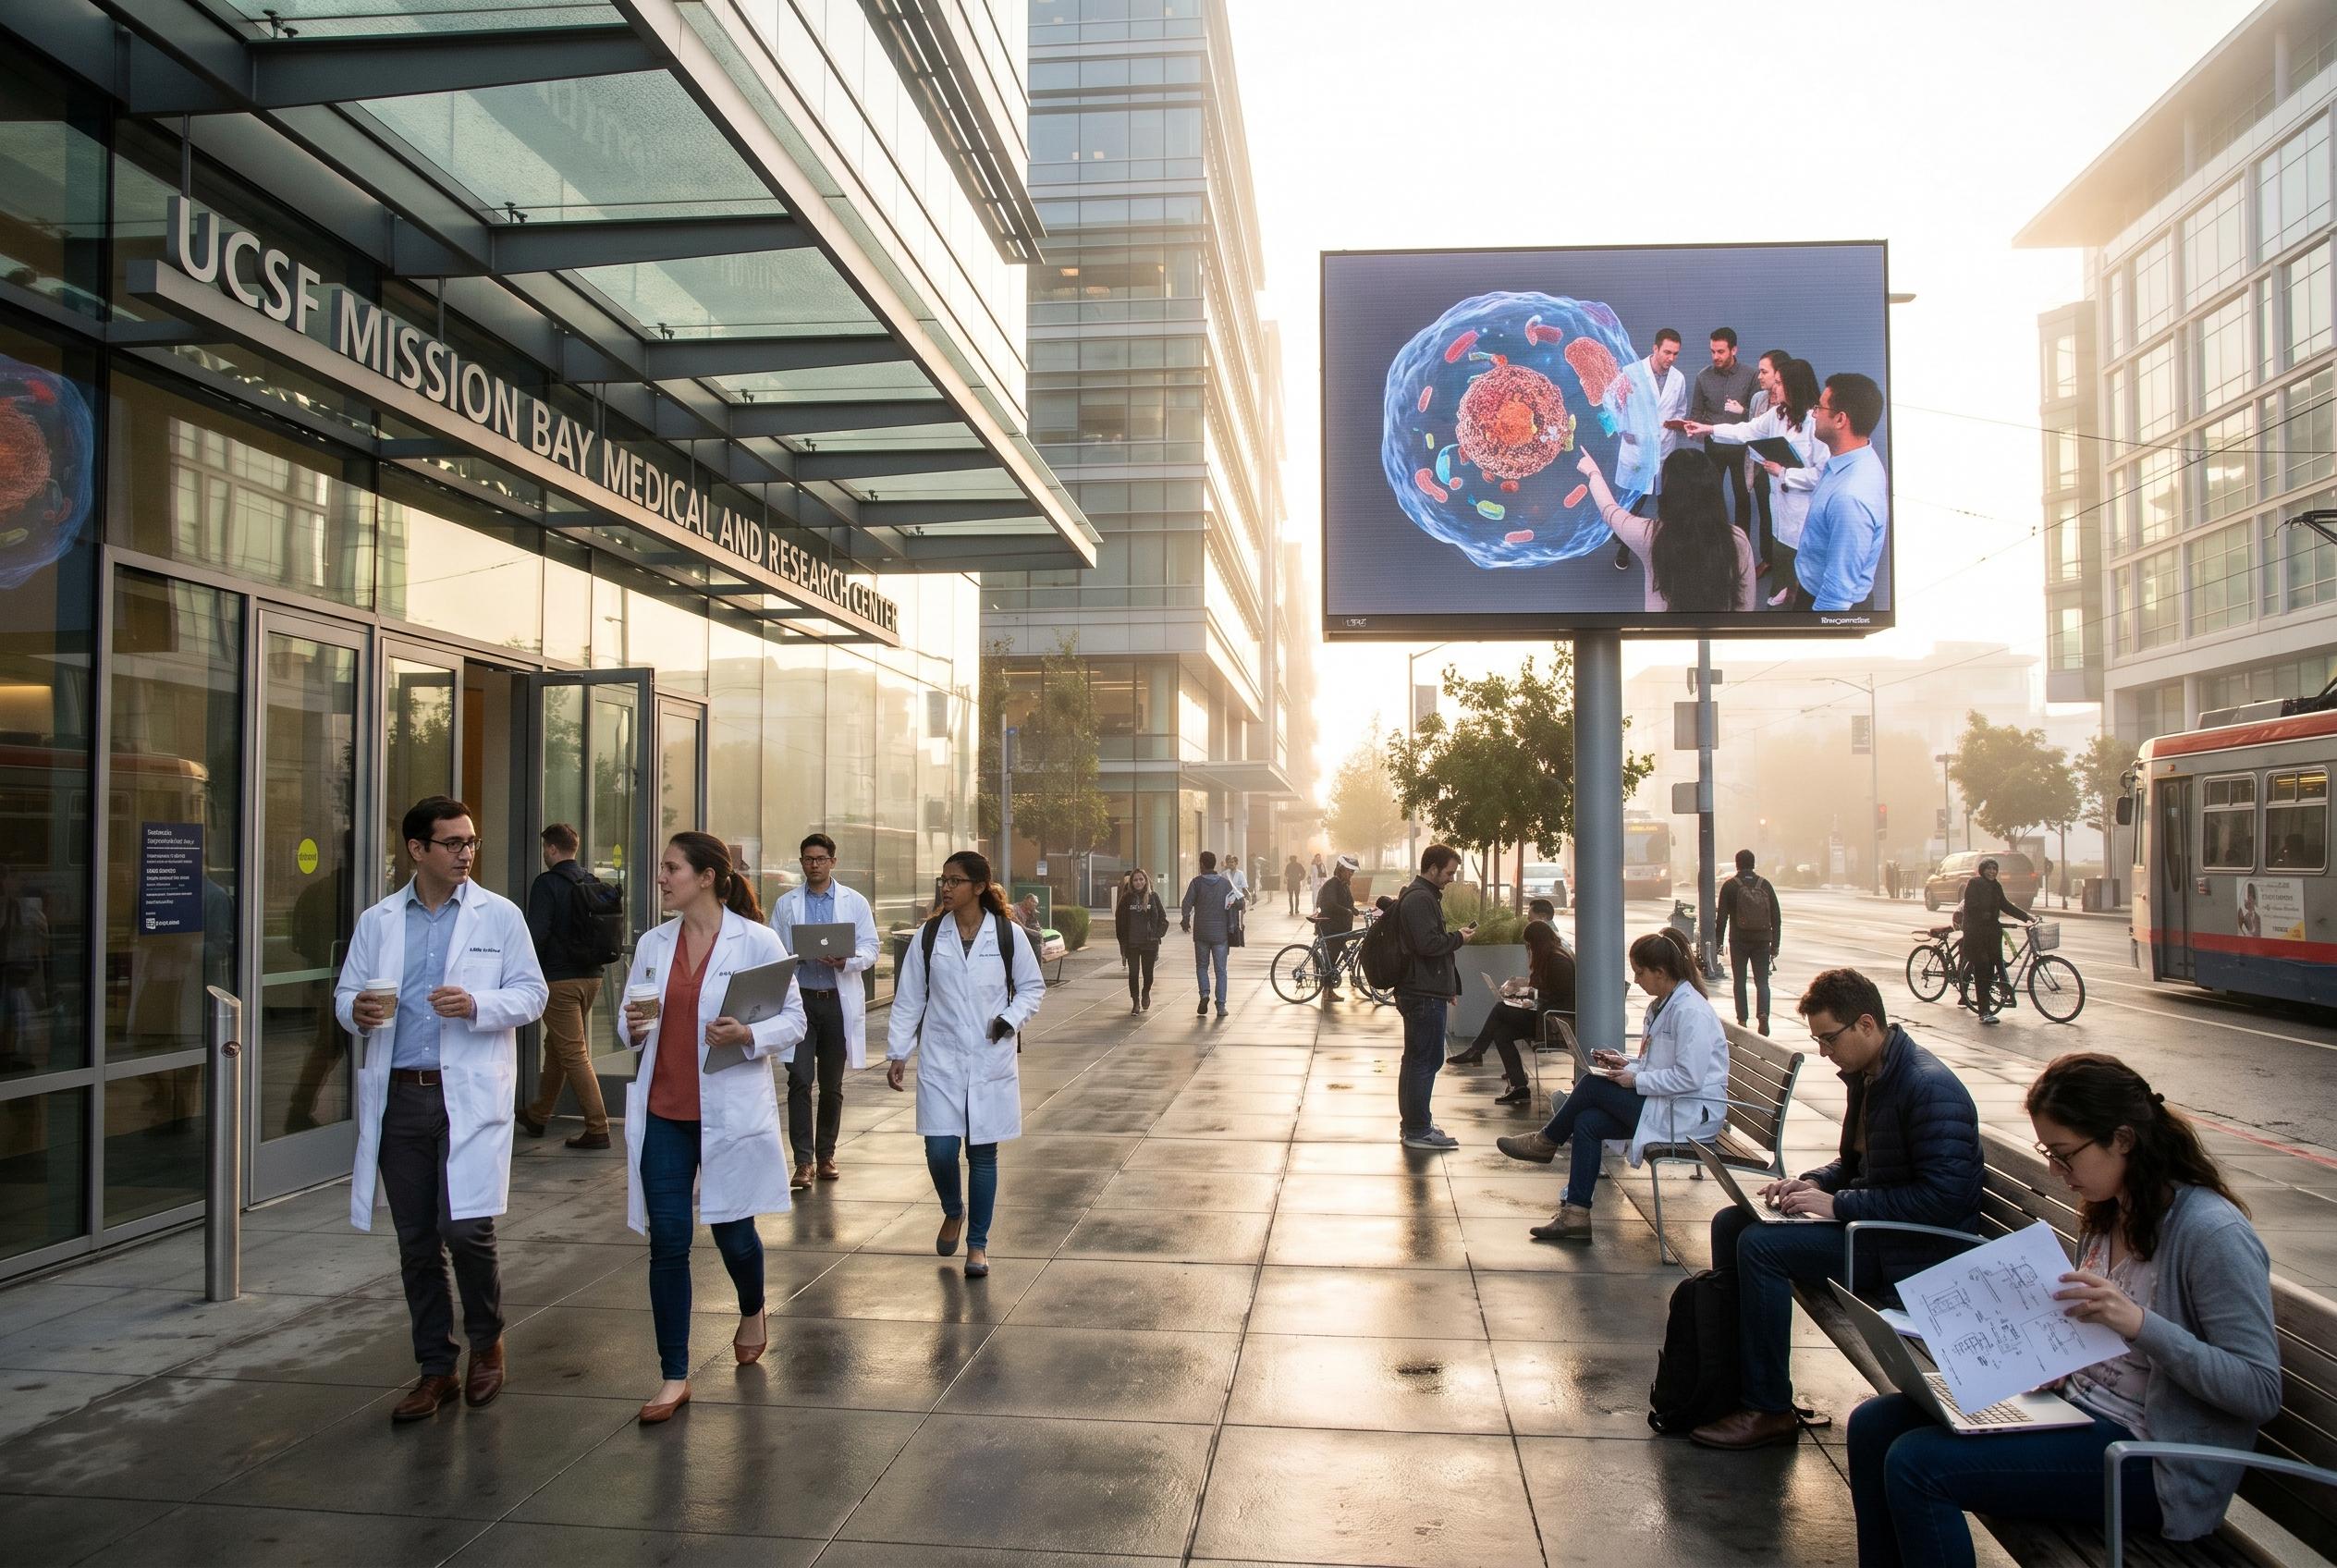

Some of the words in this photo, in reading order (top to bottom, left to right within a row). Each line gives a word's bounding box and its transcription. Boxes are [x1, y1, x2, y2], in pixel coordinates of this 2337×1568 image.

[178, 196, 321, 334] UCSF
[339, 289, 518, 442] MISSION
[532, 398, 595, 479] BAY
[604, 438, 714, 542] MEDICAL
[718, 507, 763, 564] AND
[768, 532, 851, 611] RESEARCH
[852, 582, 899, 634] CENTER
